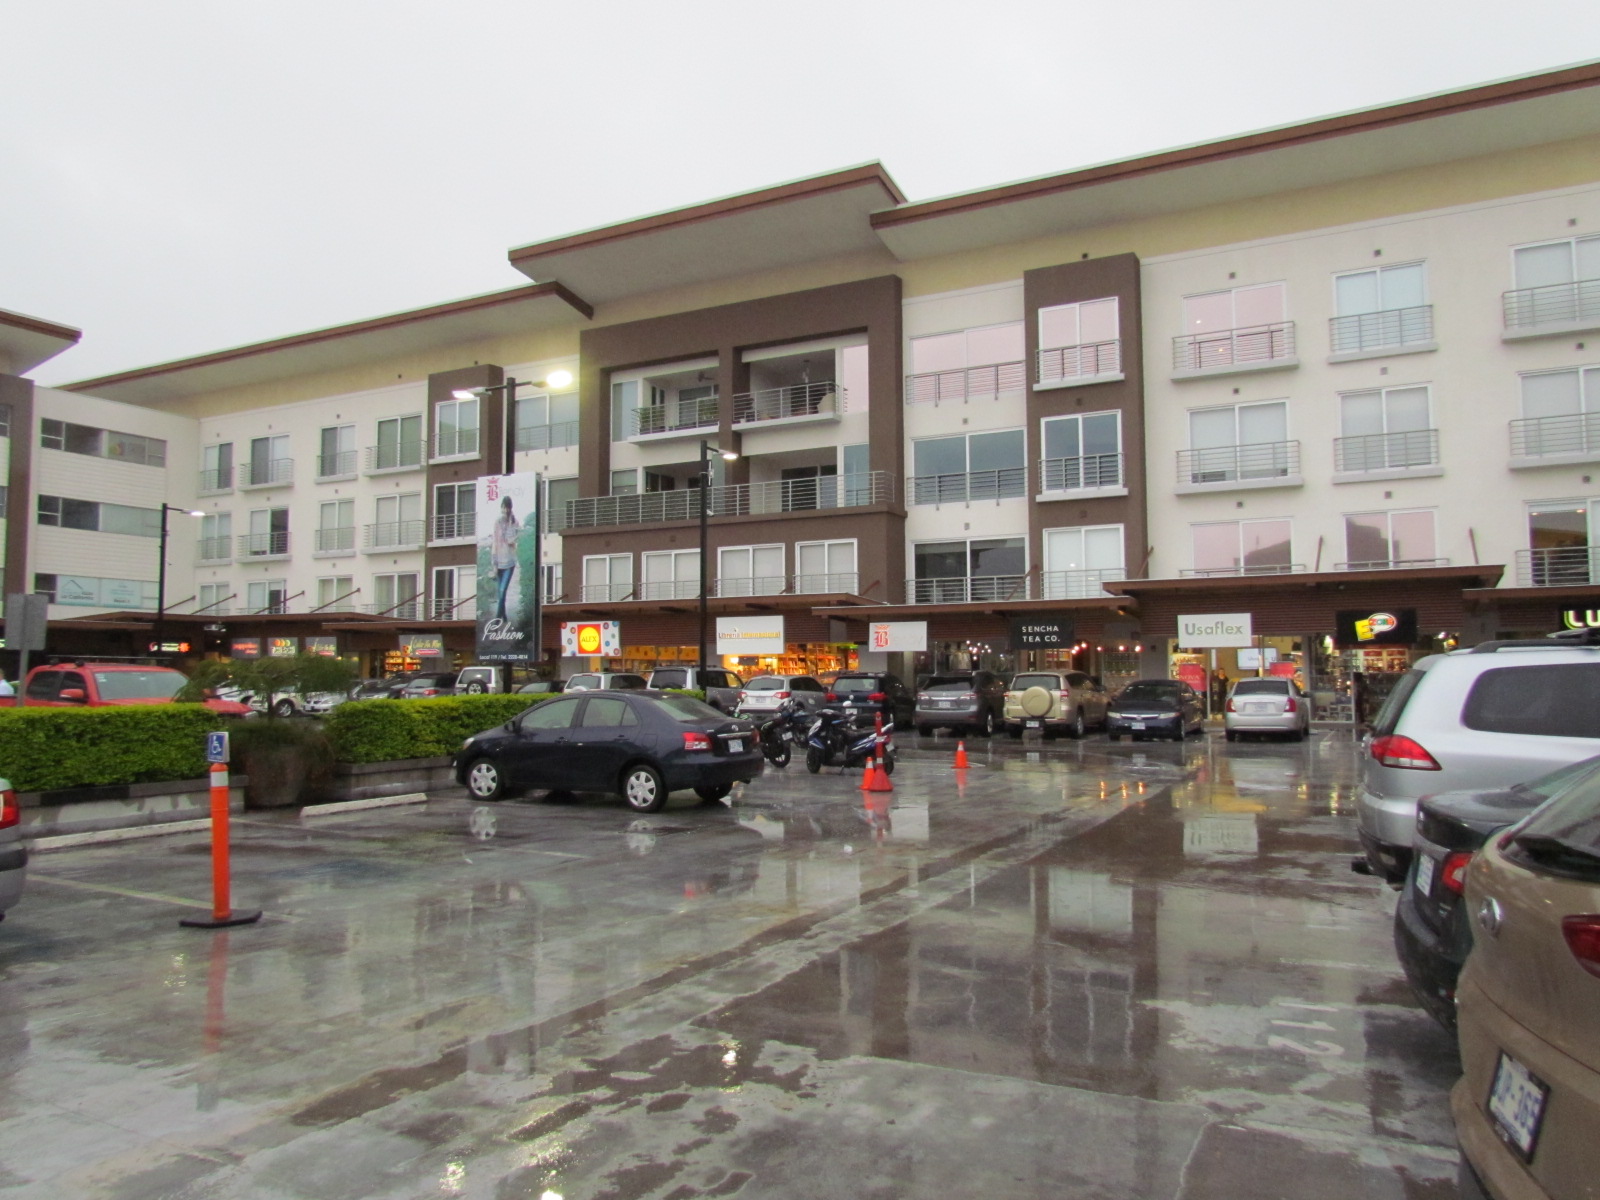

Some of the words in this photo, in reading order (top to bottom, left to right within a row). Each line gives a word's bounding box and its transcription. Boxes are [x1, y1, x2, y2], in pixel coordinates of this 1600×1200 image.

[482, 617, 525, 641] Fashion
[1021, 625, 1059, 633] SENCHA
[1184, 621, 1243, 636] Usaflex
[581, 635, 598, 643] ALEX
[1022, 635, 1041, 643] TEA
